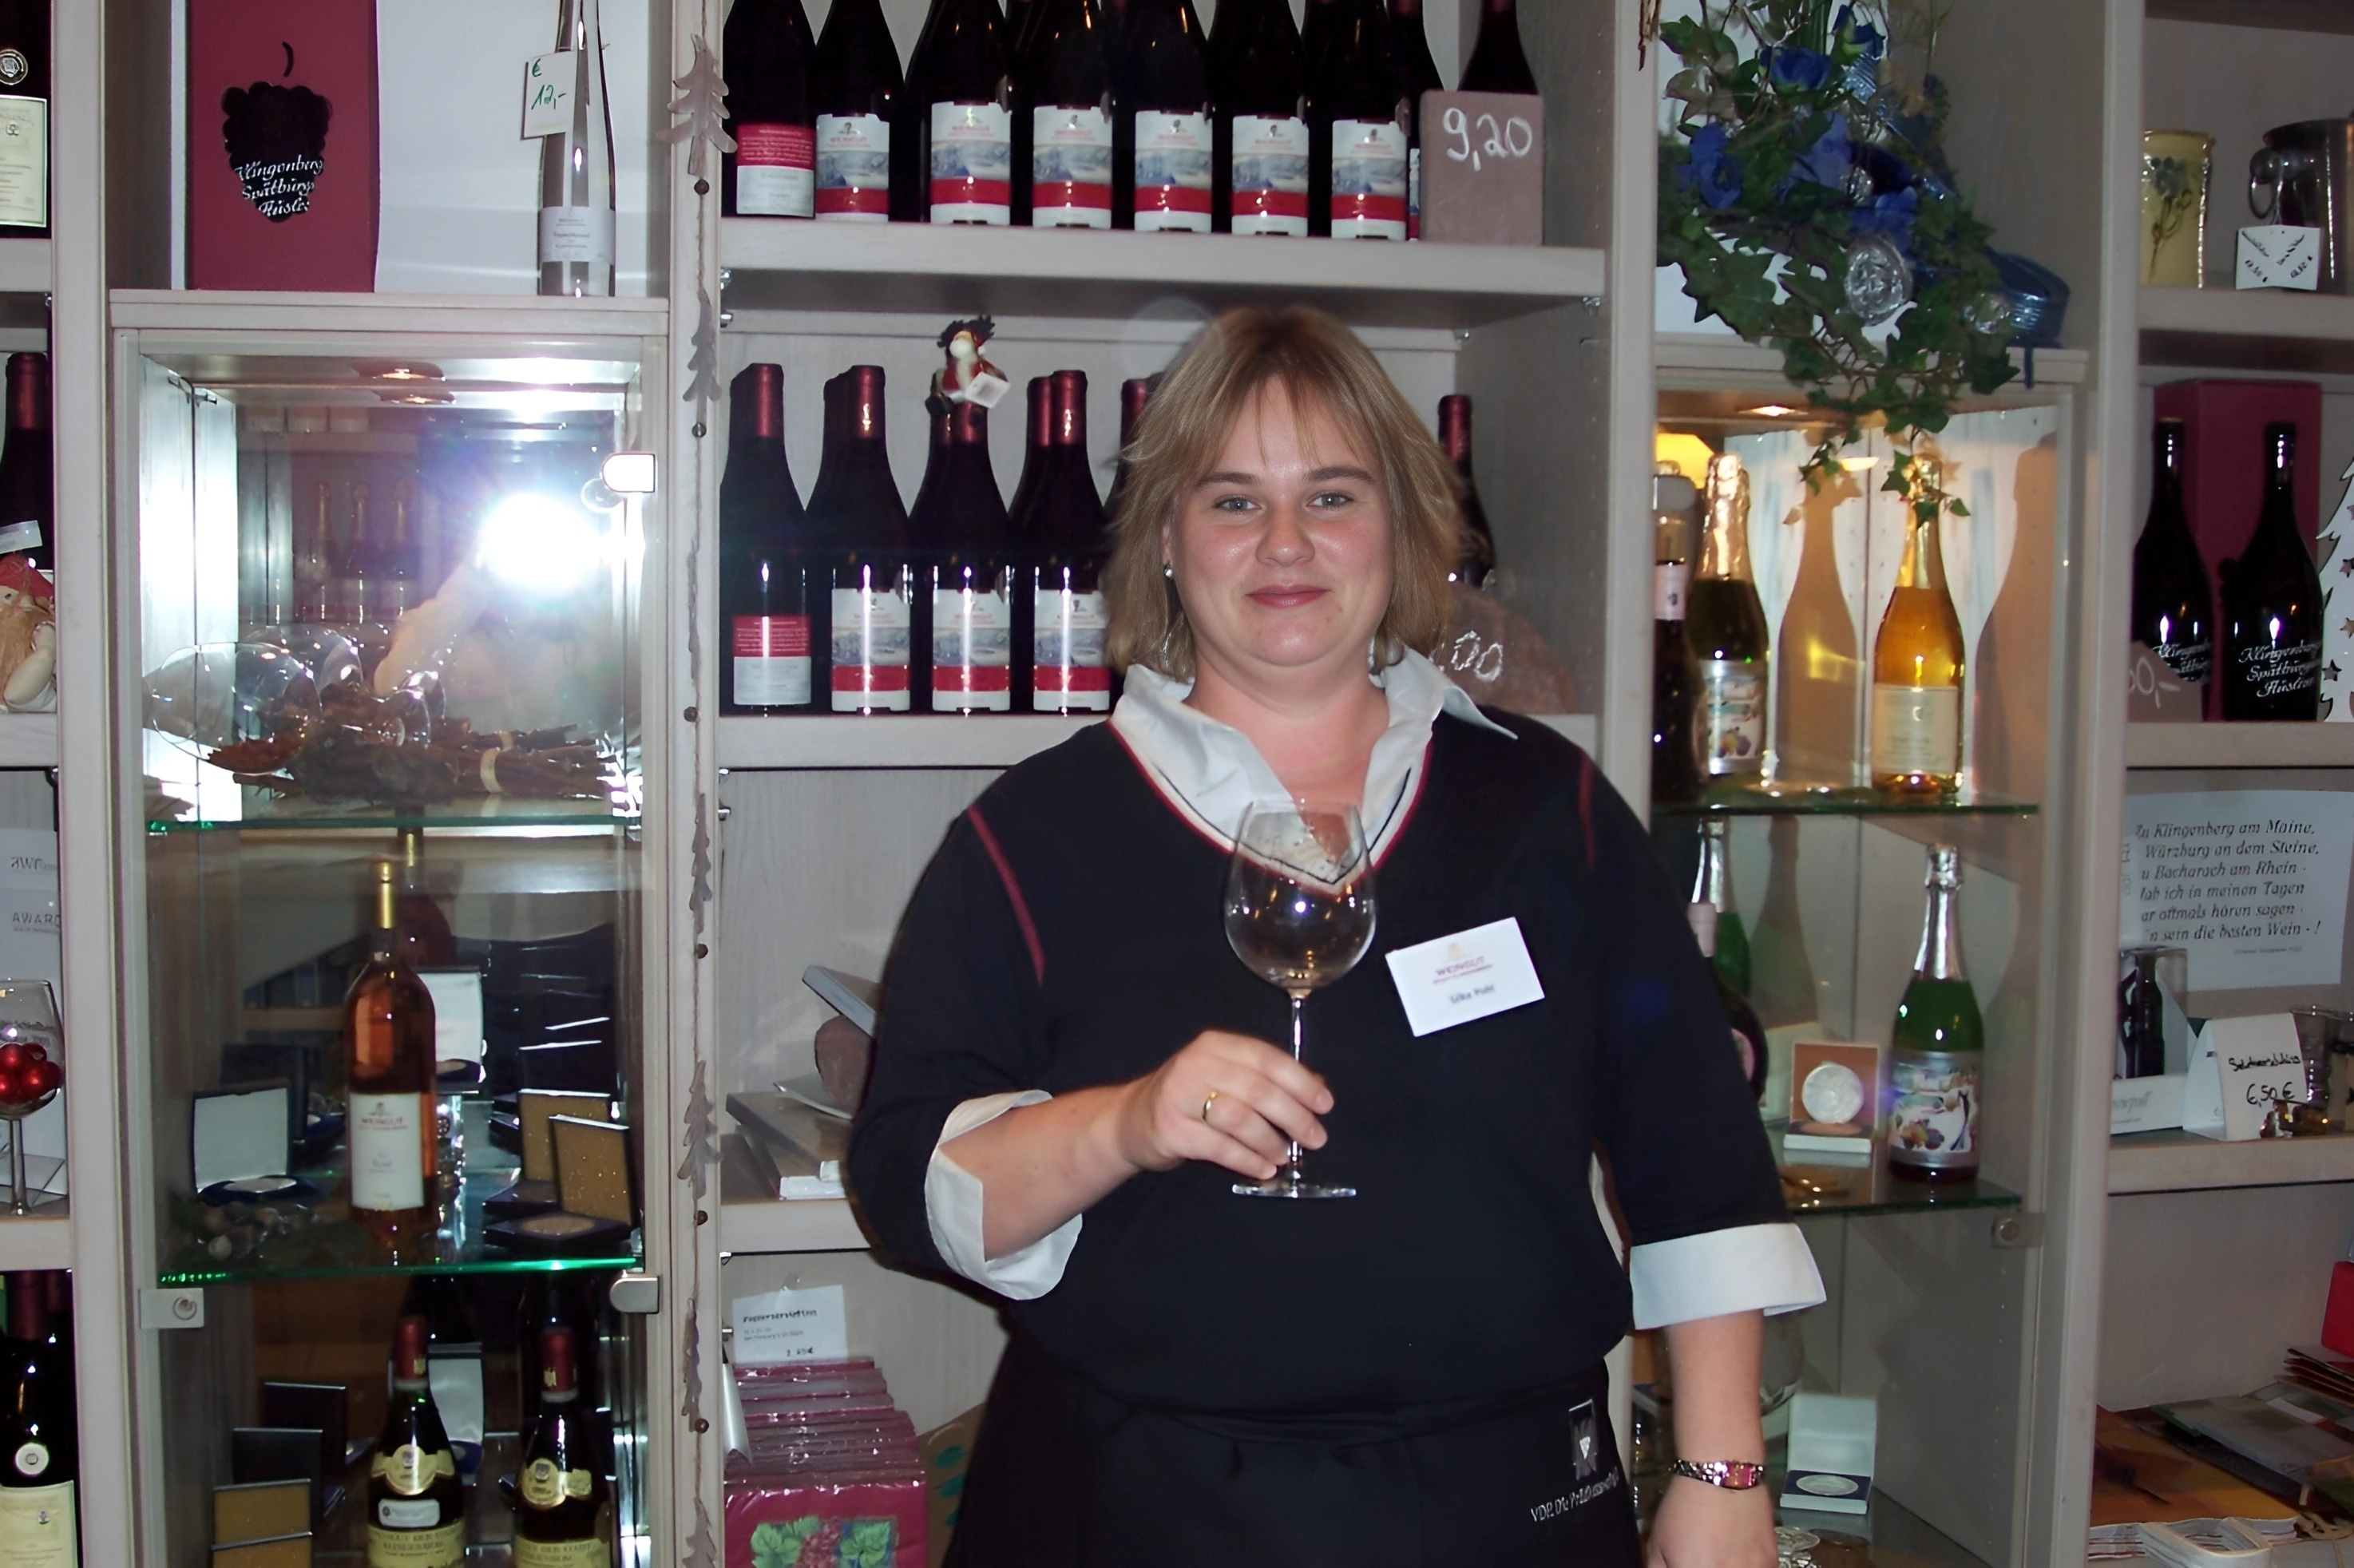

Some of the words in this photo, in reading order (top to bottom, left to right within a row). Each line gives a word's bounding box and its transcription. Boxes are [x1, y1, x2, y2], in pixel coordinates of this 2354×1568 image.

[1442, 107, 1533, 172] 9,20
[2154, 821, 2235, 839] Klingenberg
[2239, 824, 2261, 834] am
[2214, 845, 2231, 857] an
[2236, 839, 2265, 855] dem
[2229, 865, 2251, 876] am
[2256, 860, 2297, 875] Rhein
[2165, 884, 2184, 900] ich
[2189, 884, 2201, 899] in
[2206, 882, 2257, 898] meinen
[2264, 881, 2304, 899] Tagen
[2194, 925, 2215, 940] die
[2219, 924, 2261, 939] besten
